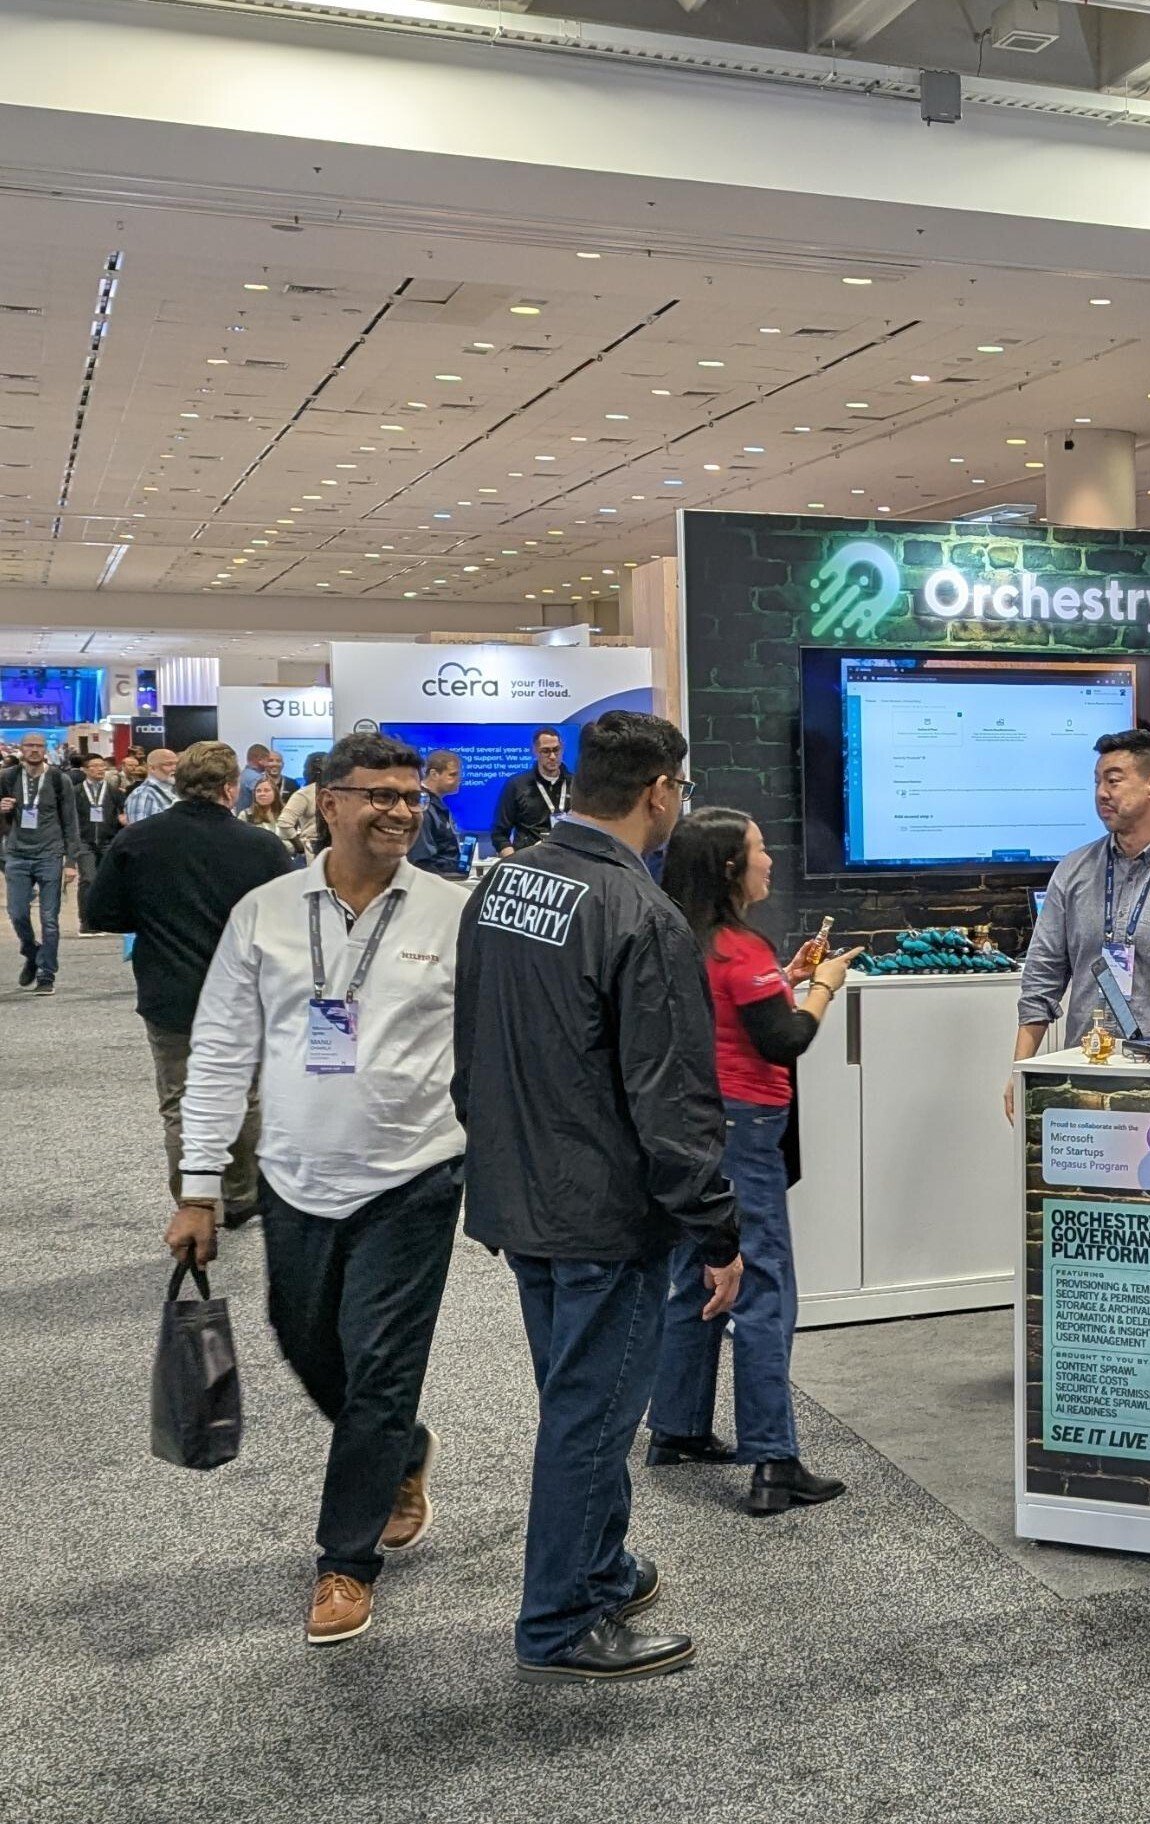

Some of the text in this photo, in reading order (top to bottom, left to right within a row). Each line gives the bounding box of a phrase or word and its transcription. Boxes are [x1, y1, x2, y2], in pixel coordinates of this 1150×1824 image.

[422, 675, 499, 697] ctera
[511, 679, 563, 689] your files.
[511, 689, 571, 699] your cloud.
[497, 867, 574, 909] TENANT
[483, 895, 569, 940] SECURITY
[1050, 1121, 1068, 1129] Proud
[1078, 1121, 1113, 1131] collaborate
[1114, 1123, 1126, 1131] with
[1050, 1132, 1094, 1144] Microsoft
[1050, 1146, 1104, 1158] for Startups
[1051, 1159, 1129, 1173] Pegasus Program
[1051, 1242, 1149, 1265] PLATFORM
[1056, 1269, 1105, 1278] FEATURING
[1056, 1278, 1120, 1292] PROVISIONING
[1121, 1283, 1129, 1292] &
[1056, 1289, 1099, 1300] SECURITY
[1101, 1292, 1108, 1302] &
[1056, 1300, 1099, 1312] STORAGE
[1099, 1303, 1107, 1313] &
[1056, 1311, 1115, 1325] AUTOMATION
[1117, 1315, 1124, 1325] &
[1056, 1321, 1107, 1335] REPORTING
[1109, 1325, 1116, 1335] &
[1056, 1332, 1147, 1349] USER MANAGEMENT
[1056, 1352, 1097, 1360] BROUGHT
[1056, 1360, 1138, 1377] CONTENT SPRAWL
[1056, 1371, 1129, 1387] STORAGE COSTS
[1056, 1382, 1099, 1394] SECURITY
[1101, 1386, 1108, 1396] &
[1056, 1393, 1150, 1411] WORKSPACE SPRAWL
[1056, 1404, 1117, 1418] AI READINESS
[1051, 1424, 1148, 1450] SEE IT LIVE
